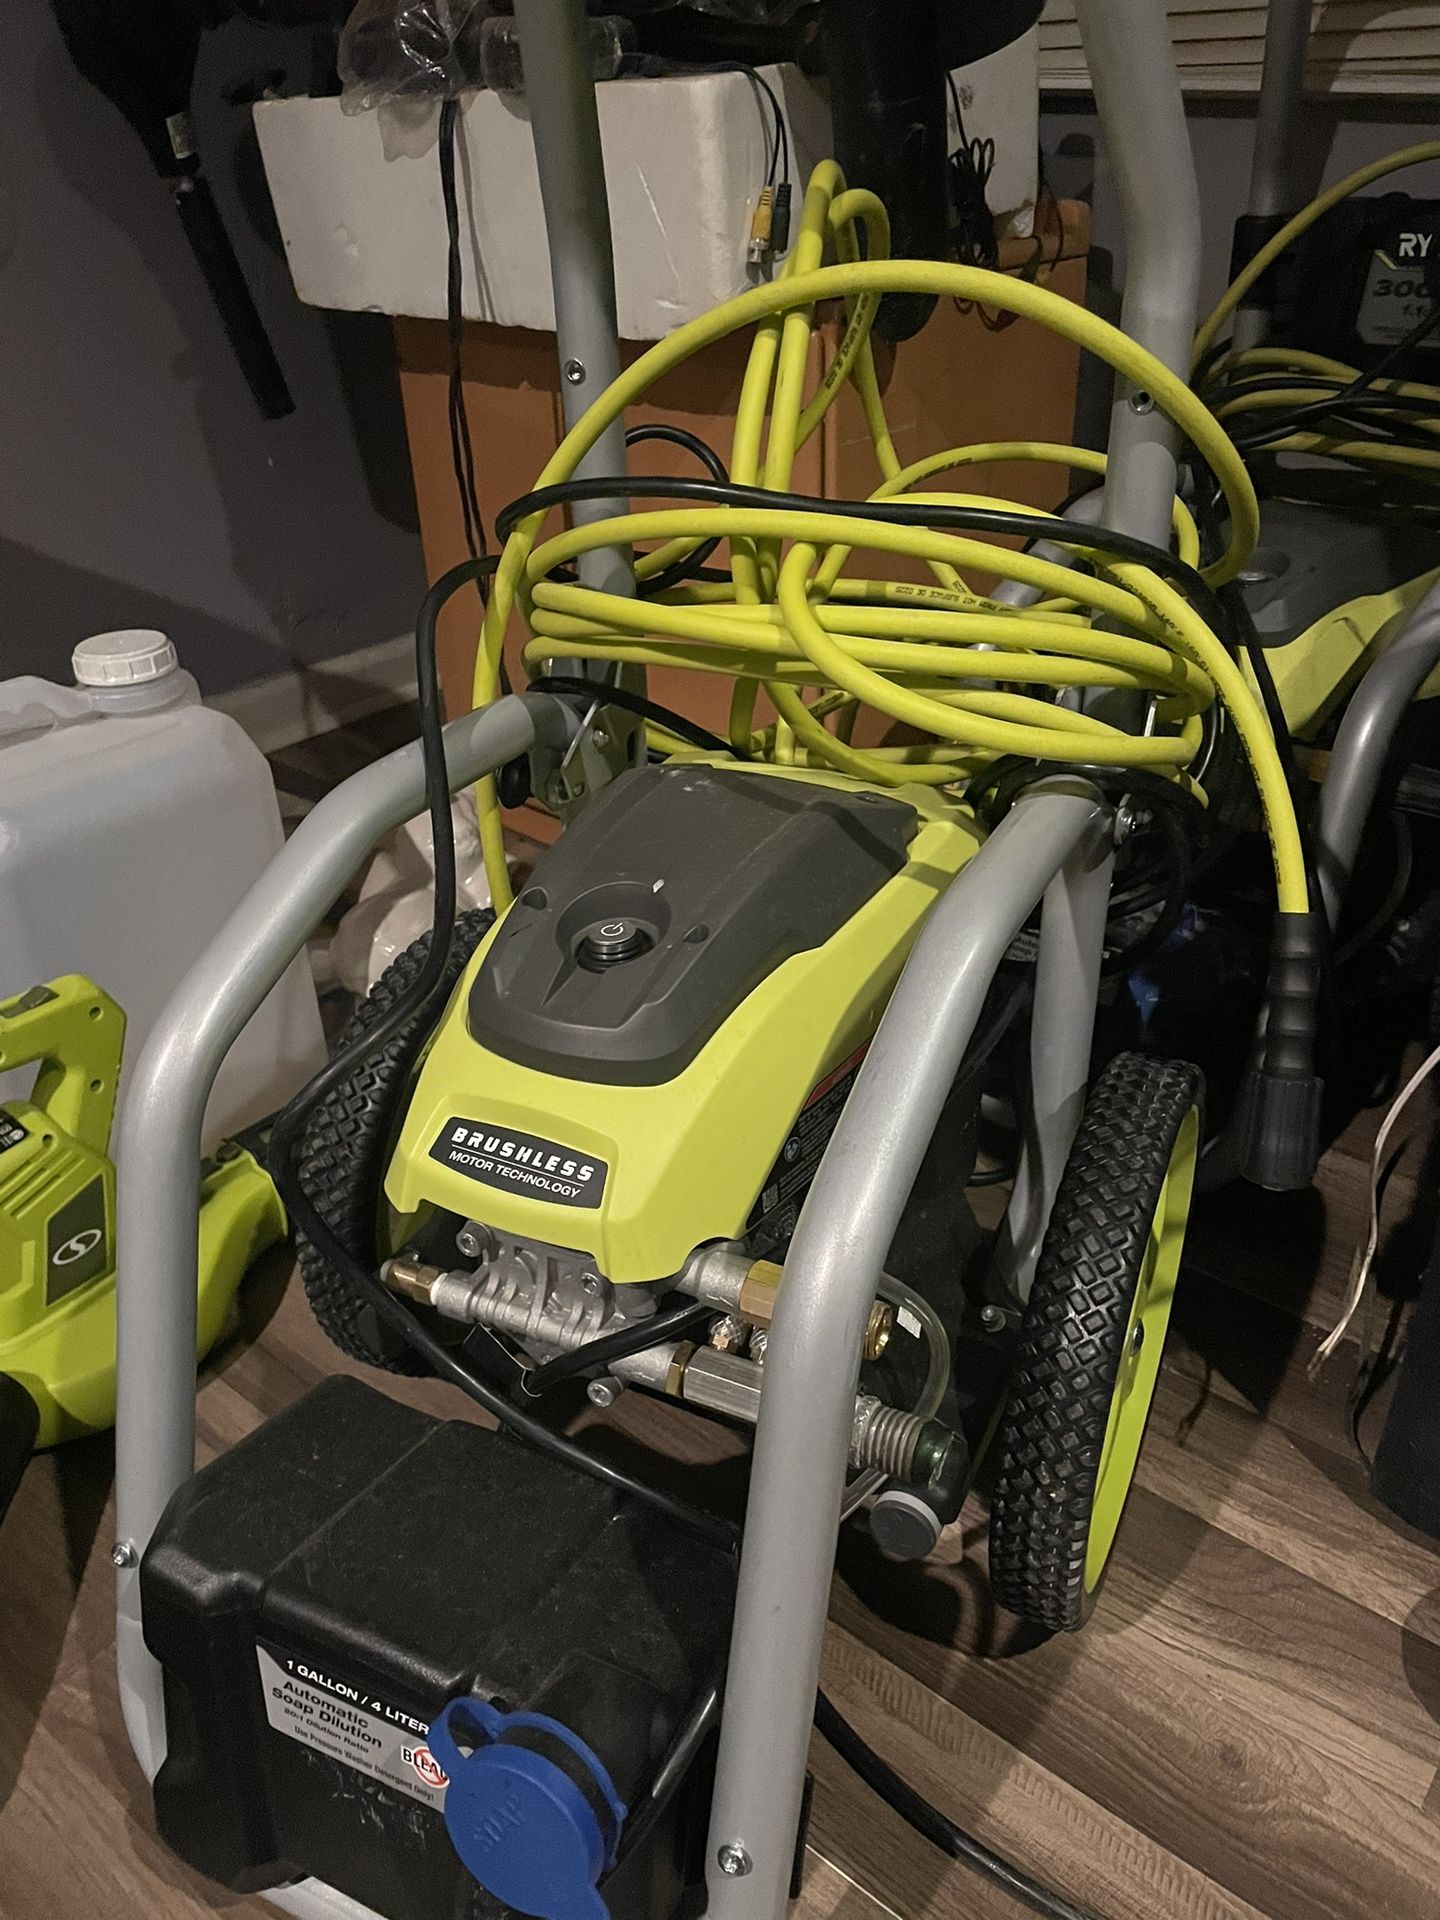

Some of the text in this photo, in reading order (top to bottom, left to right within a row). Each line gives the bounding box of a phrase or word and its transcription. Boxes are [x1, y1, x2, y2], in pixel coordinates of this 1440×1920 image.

[449, 1151, 581, 1198] MOTOR TECHNOLOGY
[451, 1127, 595, 1182] BRUSHLESS
[272, 1687, 383, 1749] Soap Dilution
[283, 1681, 369, 1728] Automatic
[286, 1660, 430, 1735] 1 GALLON / 4 LITER
[294, 1725, 309, 1739] Use
[310, 1733, 343, 1757] Pressure
[345, 1750, 373, 1770] Washer
[374, 1764, 412, 1790] Detergent
[306, 1716, 342, 1742] Dilution
[344, 1737, 370, 1754] Ratio
